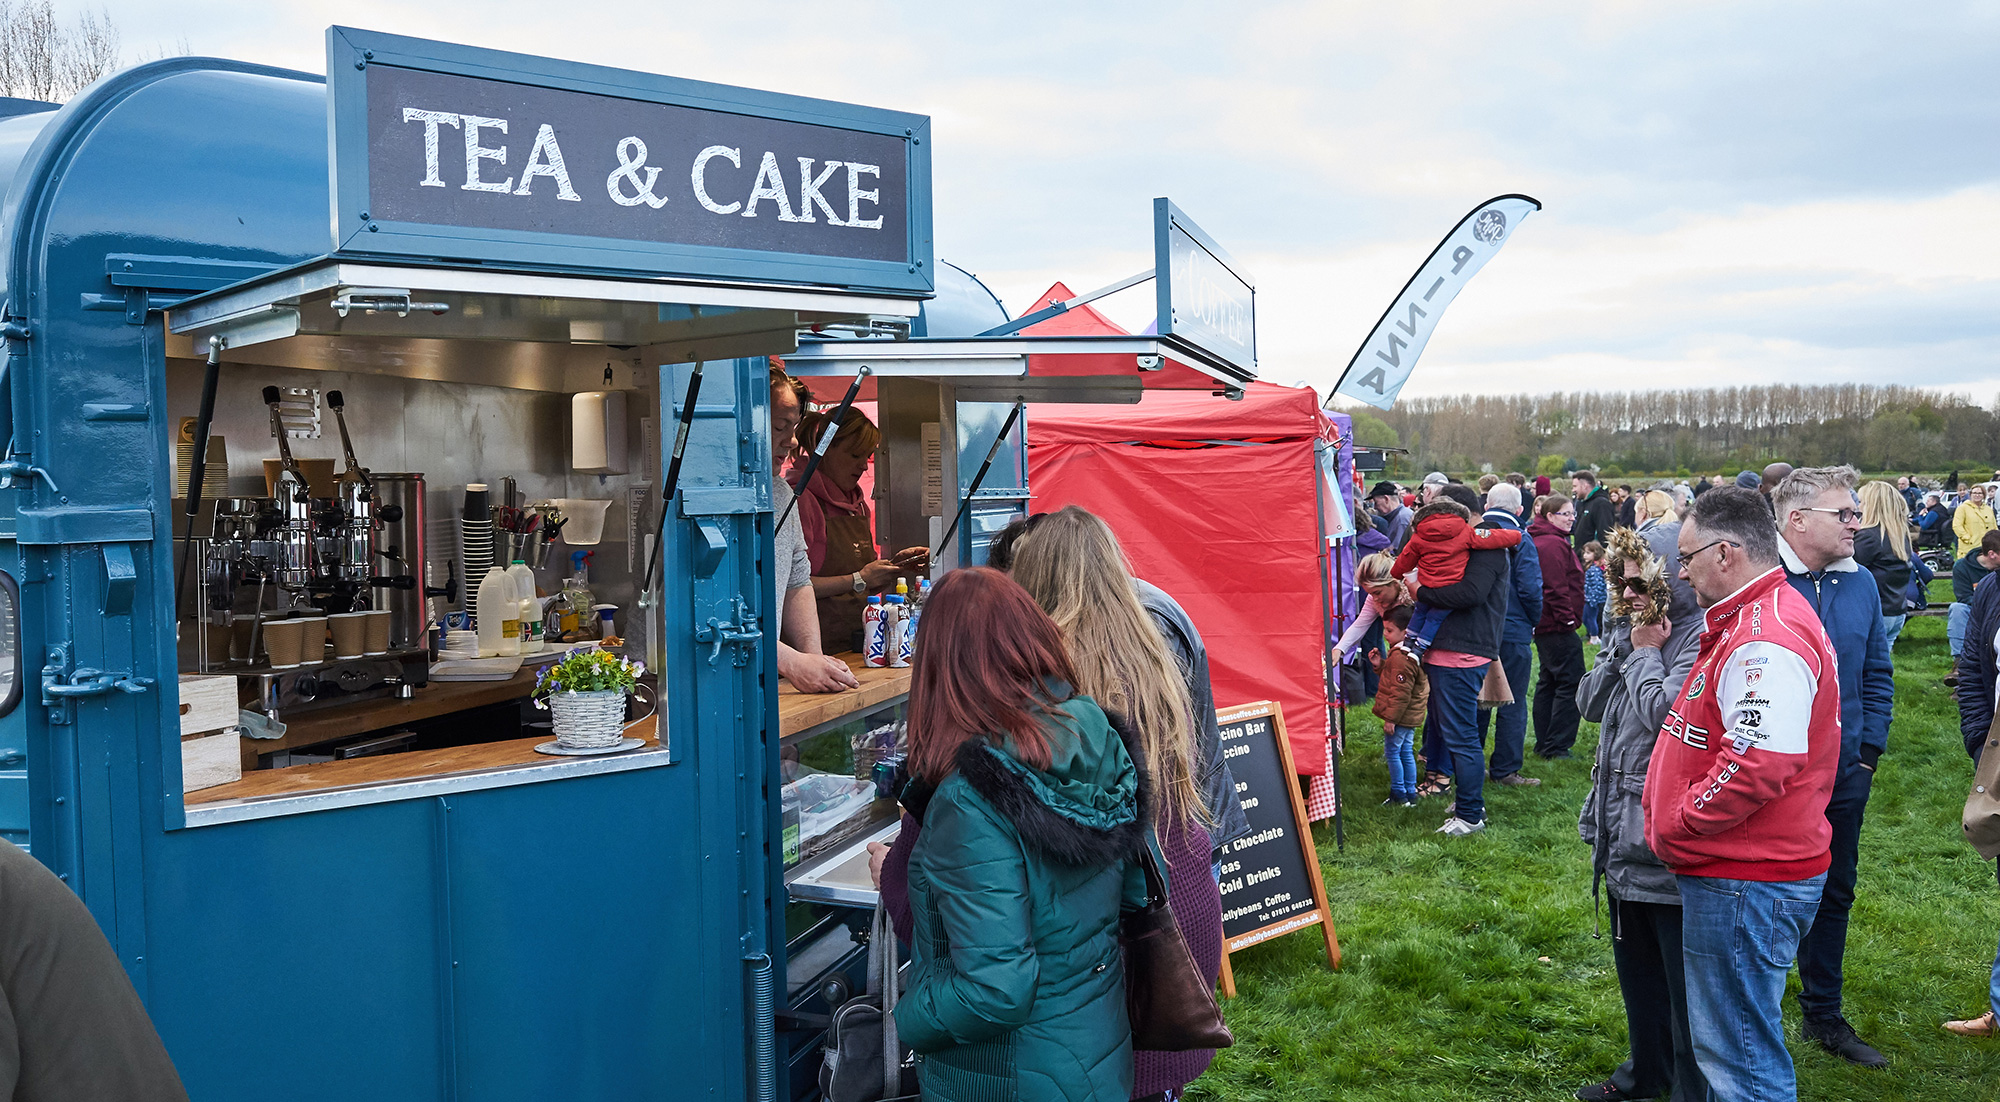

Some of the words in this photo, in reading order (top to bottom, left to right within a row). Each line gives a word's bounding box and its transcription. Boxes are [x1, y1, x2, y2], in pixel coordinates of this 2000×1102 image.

[402, 106, 582, 203] TEA
[606, 135, 669, 210] &
[690, 145, 884, 231] CAKE
[1188, 249, 1245, 347] COFFEE
[1220, 726, 1244, 741] cino
[1244, 721, 1266, 737] Bar
[1746, 728, 1768, 741] Clips
[1223, 744, 1251, 760] ccino
[1234, 781, 1248, 794] so
[1240, 796, 1260, 811] ano
[1232, 826, 1285, 853] Chocolate
[1220, 860, 1242, 876] eas
[1218, 876, 1244, 896] Cold
[1245, 866, 1283, 887] Drinks
[1264, 892, 1292, 908] Coffee
